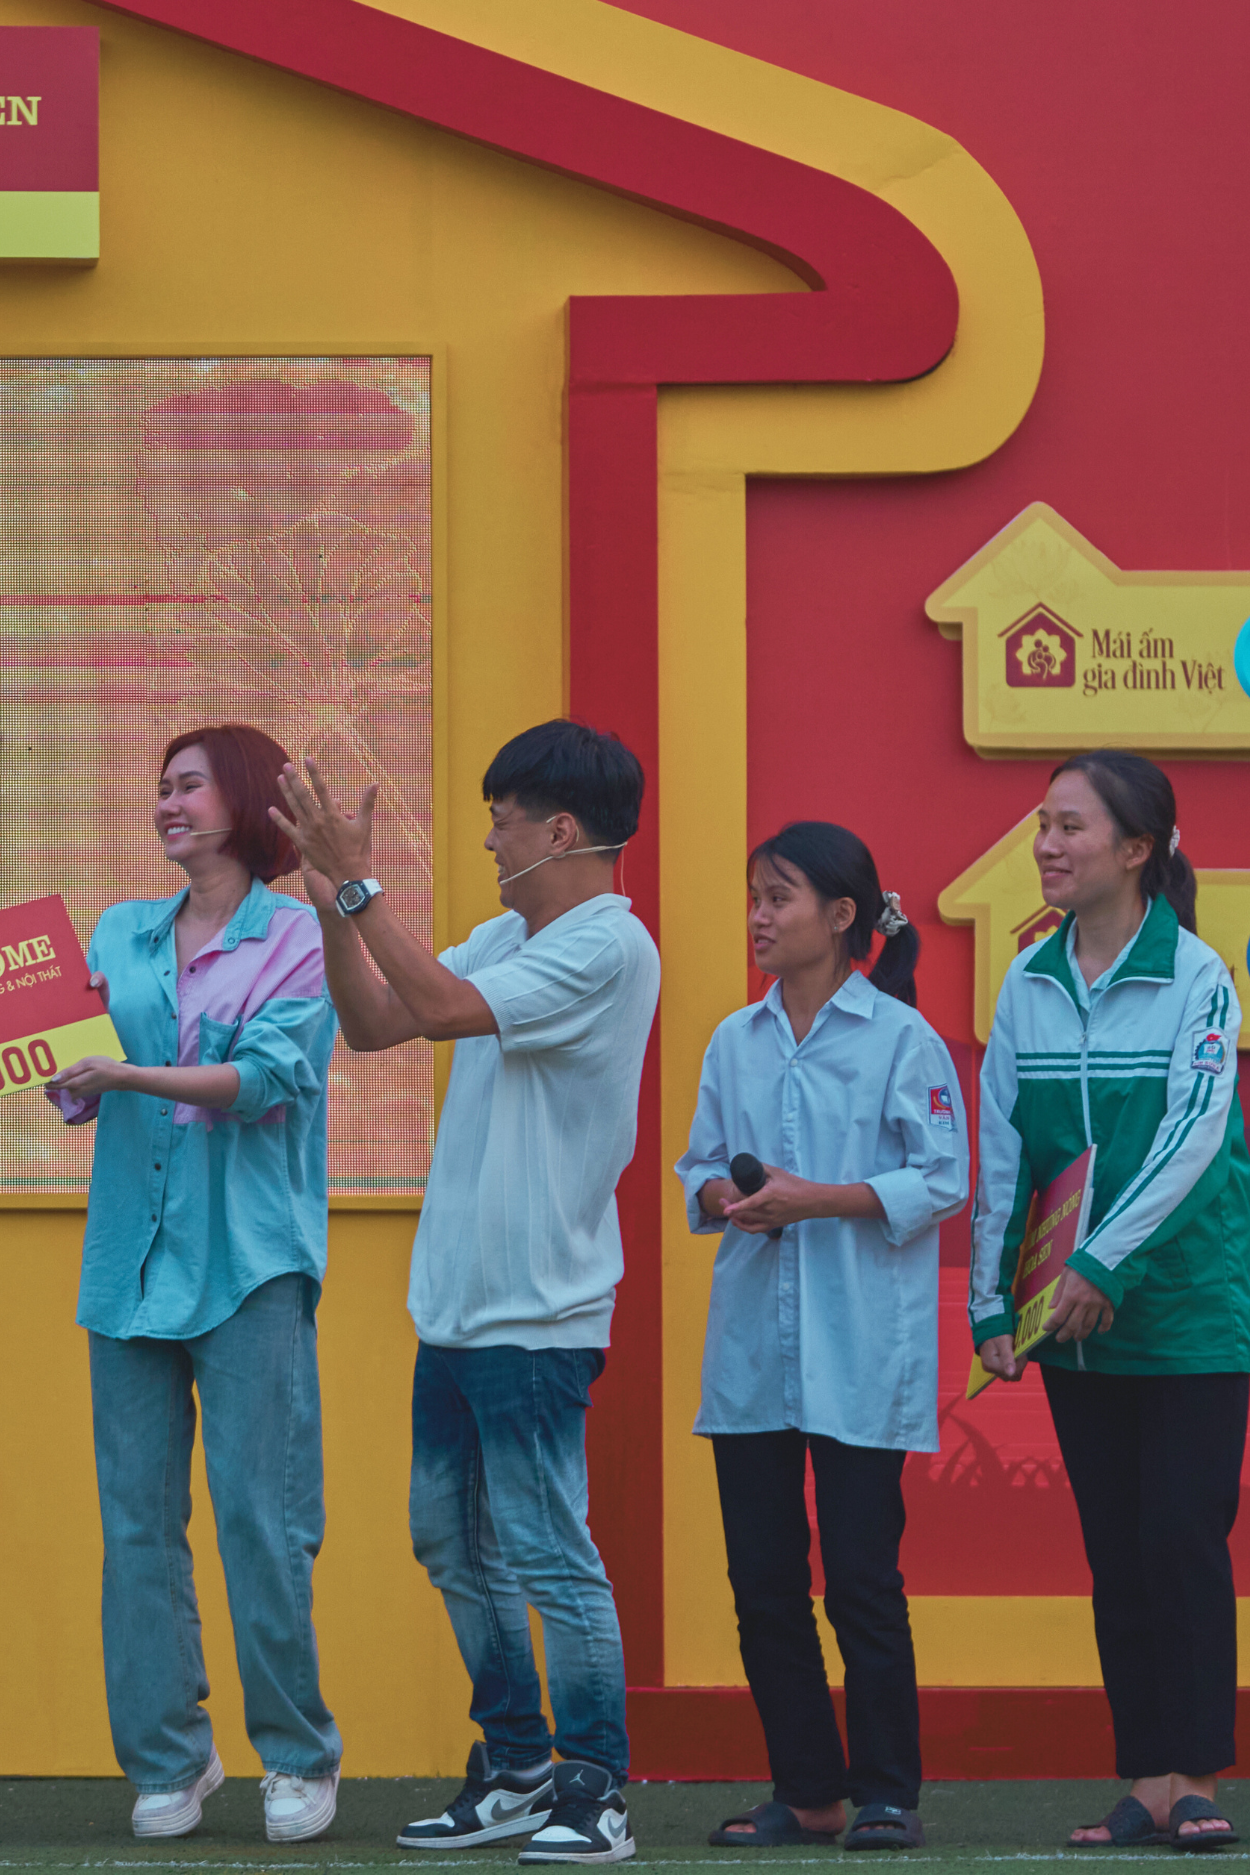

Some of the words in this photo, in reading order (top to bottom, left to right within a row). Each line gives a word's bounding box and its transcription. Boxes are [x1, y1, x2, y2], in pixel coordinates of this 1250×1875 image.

[1091, 628, 1132, 659] Mái
[1138, 627, 1175, 659] ấm
[1082, 663, 1117, 697] gia
[1123, 659, 1177, 691] đình
[1180, 659, 1226, 694] Việt
[6, 980, 15, 991] &
[16, 972, 38, 989] NỘI
[36, 965, 62, 982] THẤT
